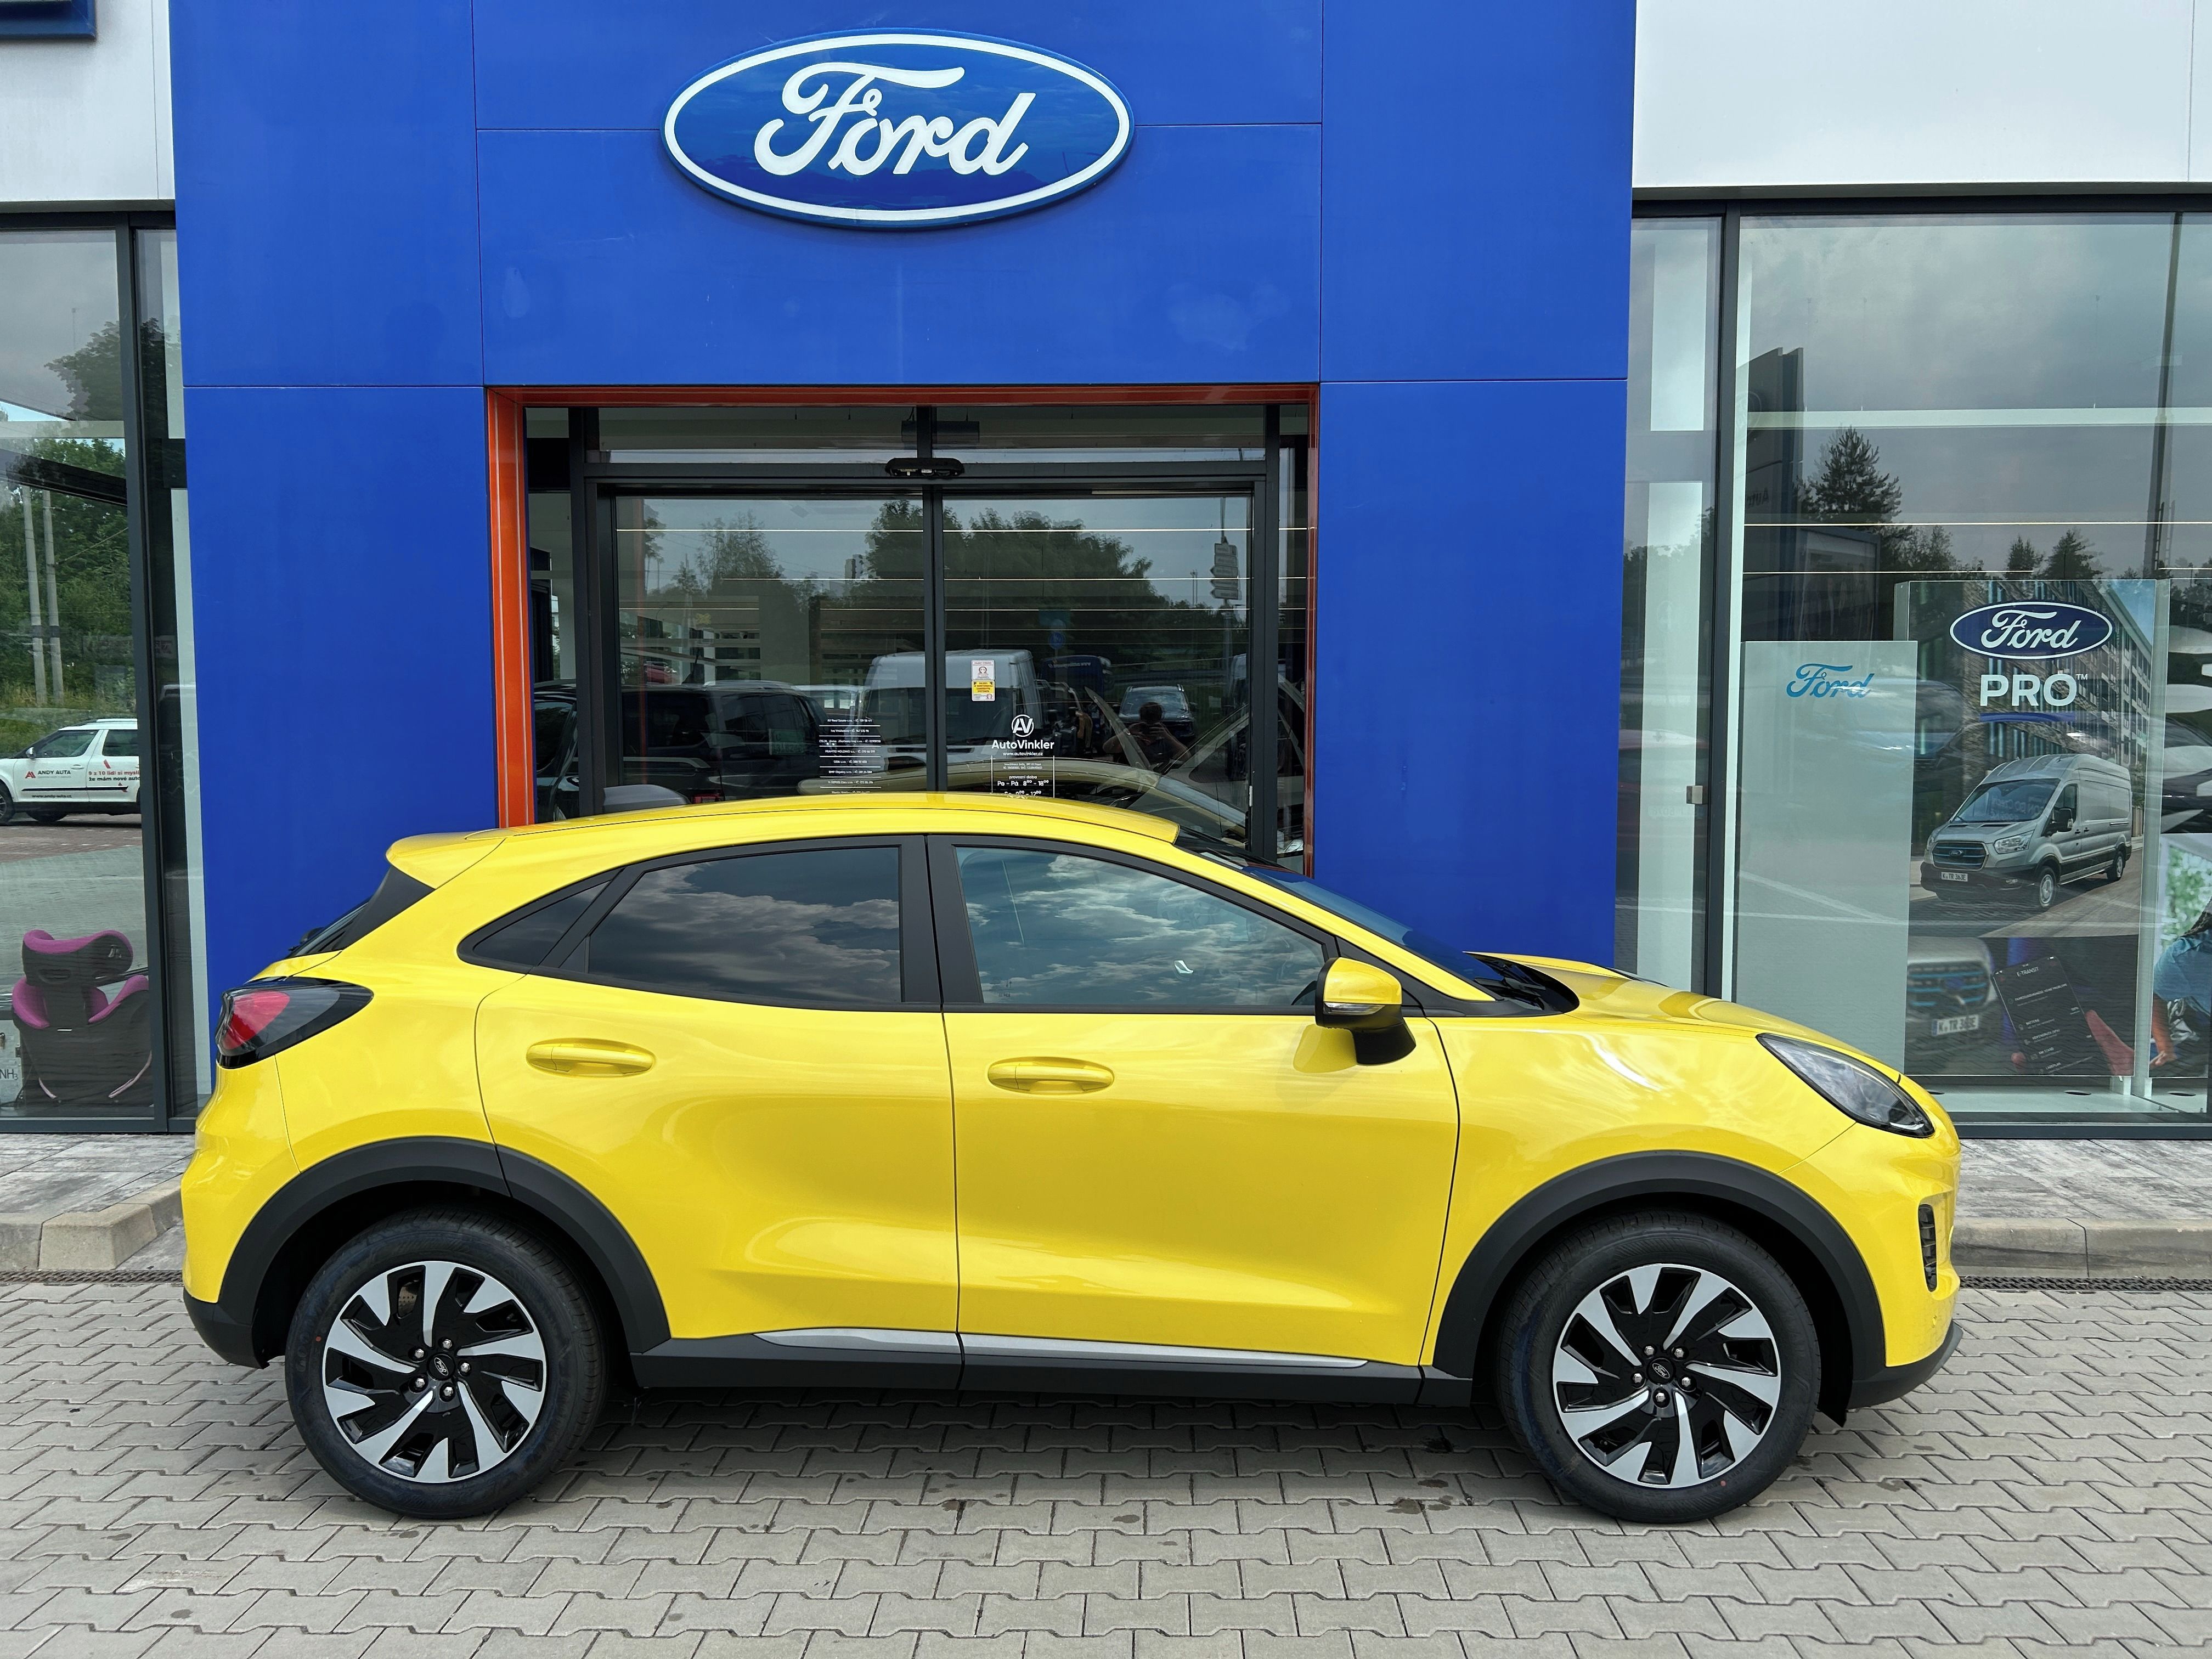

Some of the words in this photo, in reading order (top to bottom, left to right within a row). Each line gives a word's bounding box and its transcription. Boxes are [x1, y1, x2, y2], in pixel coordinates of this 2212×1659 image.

[754, 61, 1036, 176] Ford
[1981, 610, 2081, 648] Ford
[1786, 663, 1875, 698] Ford
[991, 739, 1054, 749] AutoVinkler
[2016, 966, 2040, 977] E-TRANSIT
